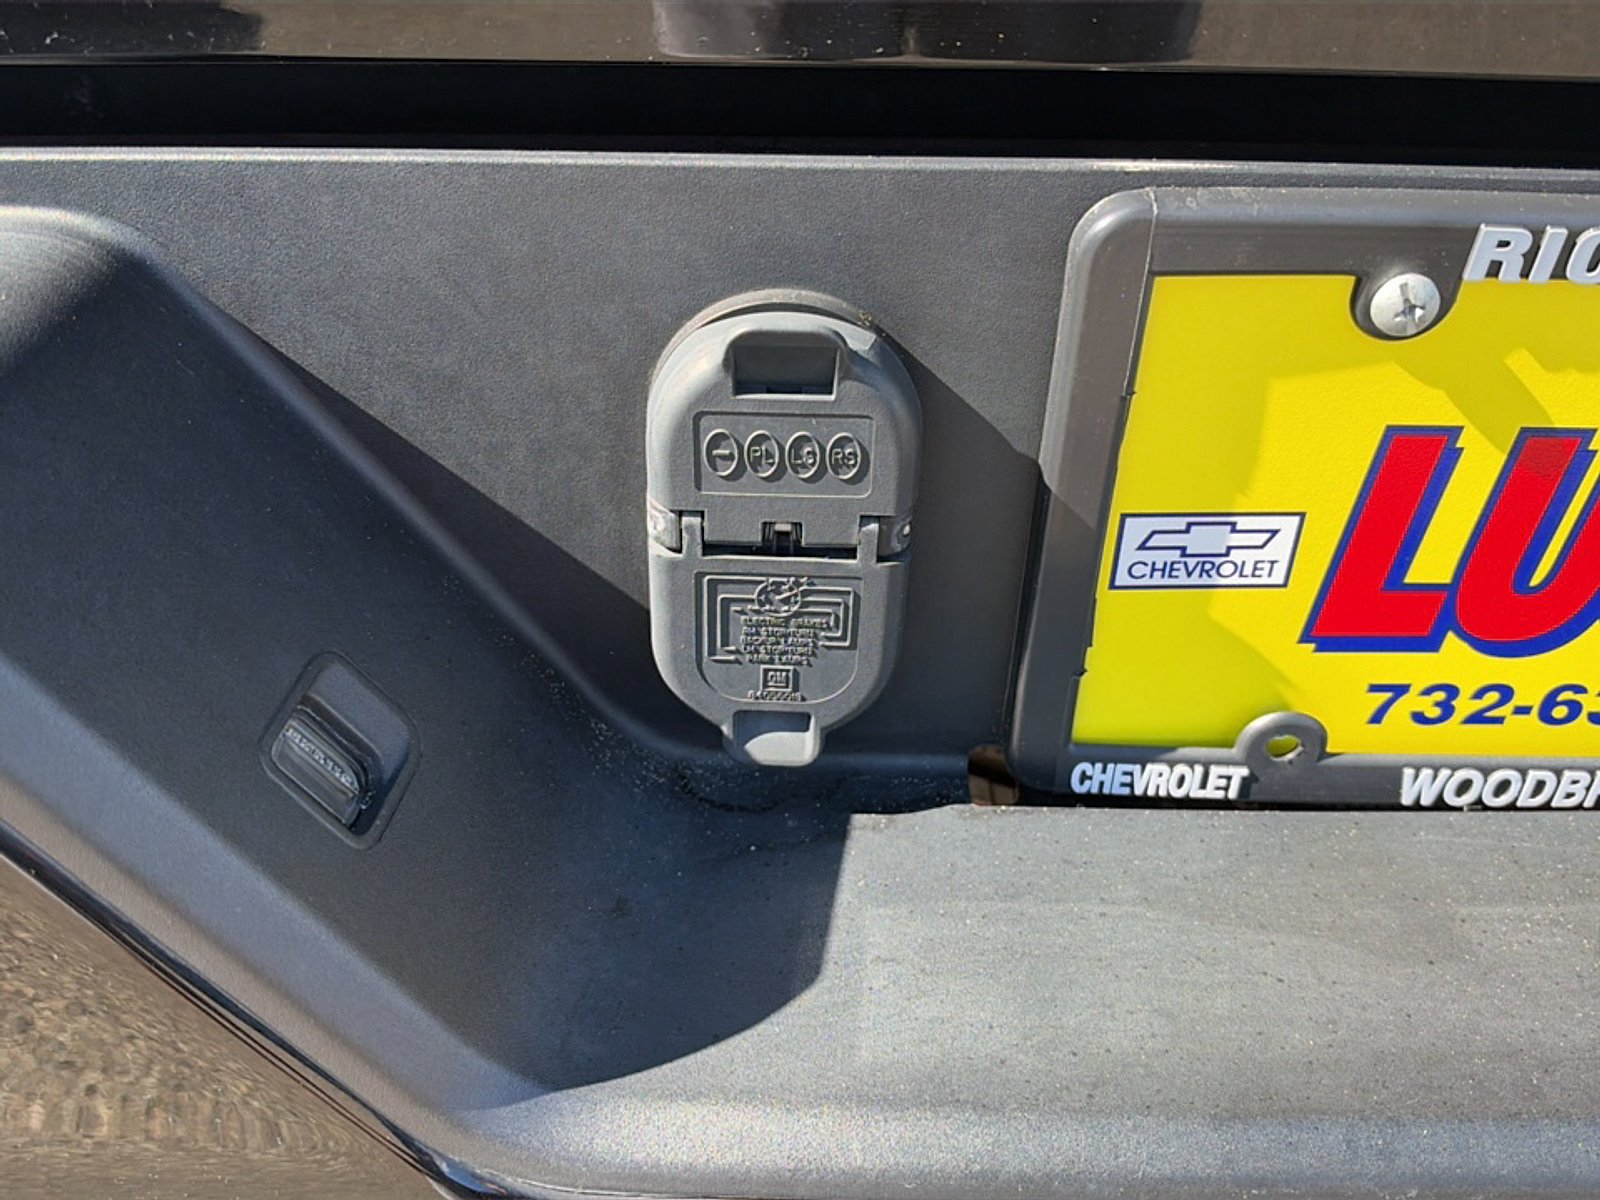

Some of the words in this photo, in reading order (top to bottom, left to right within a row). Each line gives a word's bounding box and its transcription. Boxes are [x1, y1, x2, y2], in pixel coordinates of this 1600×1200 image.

[749, 446, 775, 464] PL
[831, 448, 856, 465] RS
[1298, 425, 1600, 657] LU
[1127, 558, 1280, 581] CHEVROLET
[767, 671, 787, 684] GM
[1070, 762, 1250, 799] CHEVROLET
